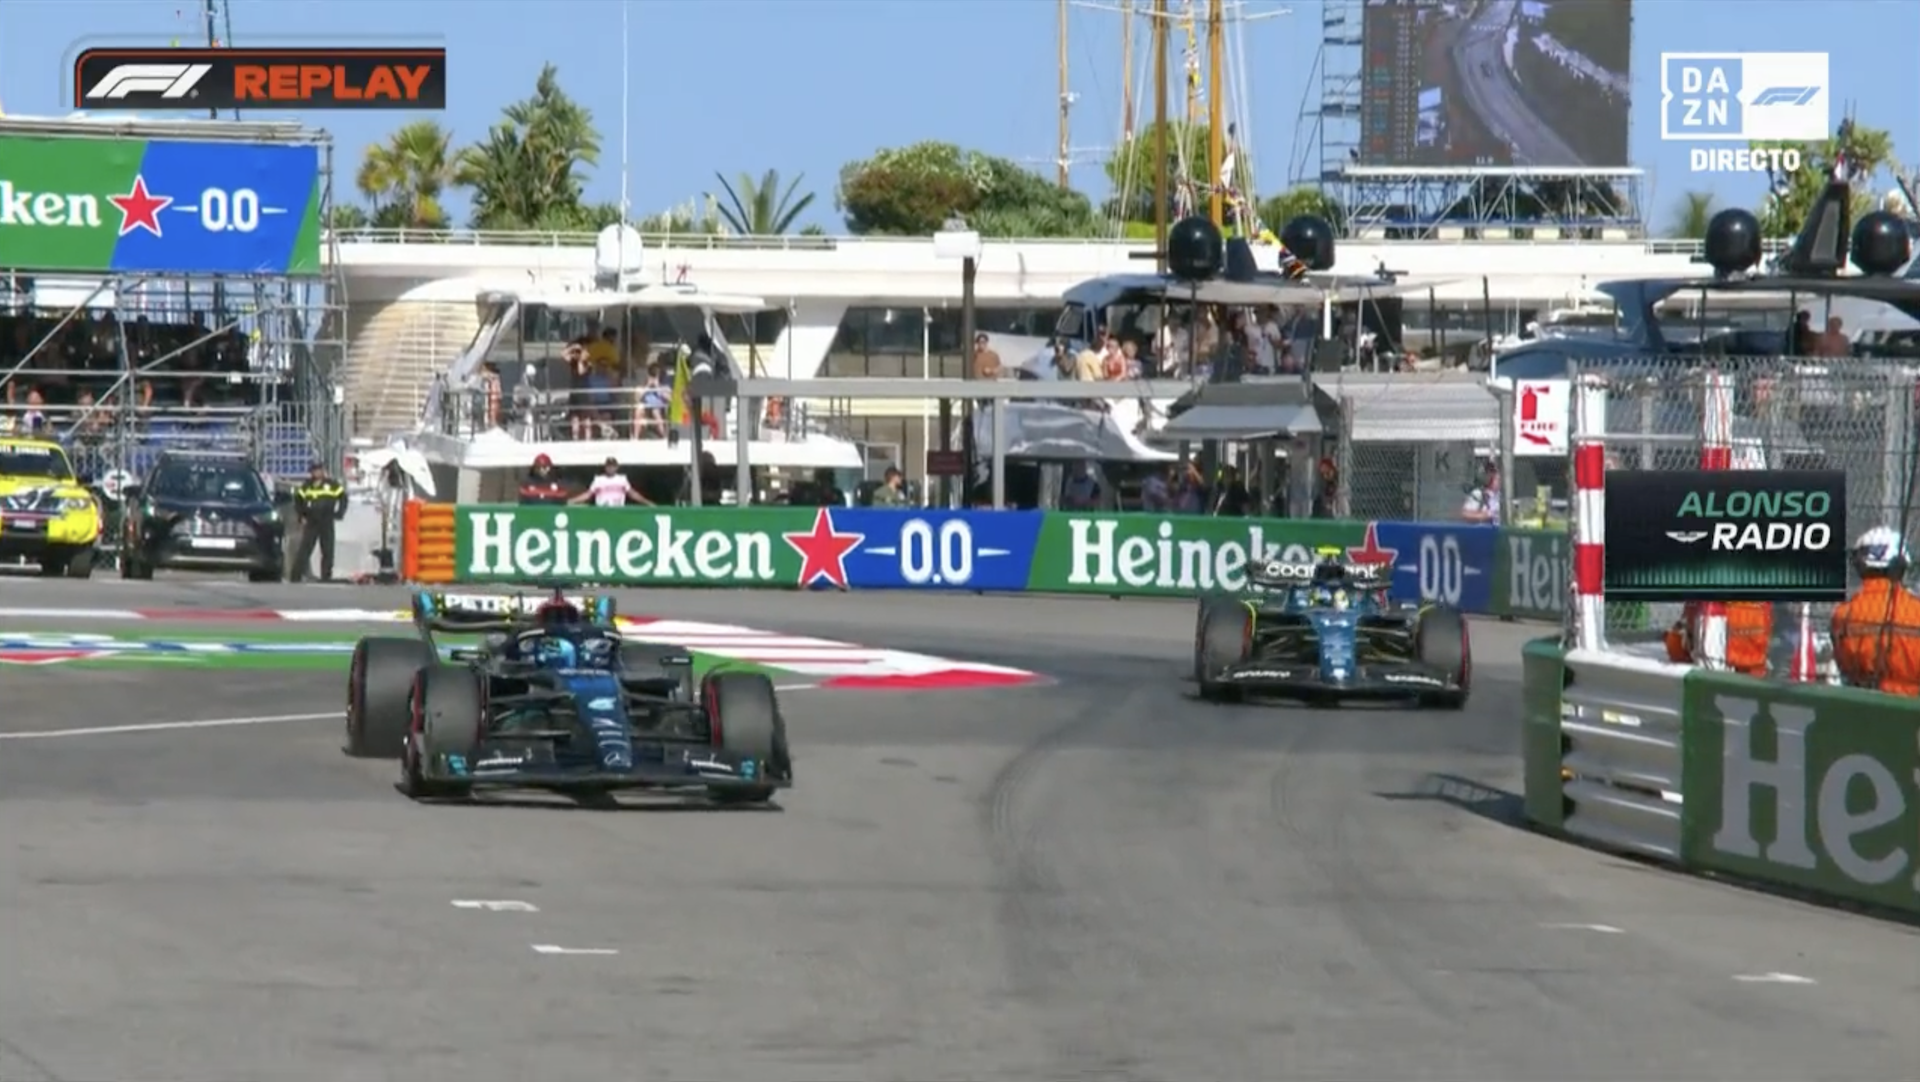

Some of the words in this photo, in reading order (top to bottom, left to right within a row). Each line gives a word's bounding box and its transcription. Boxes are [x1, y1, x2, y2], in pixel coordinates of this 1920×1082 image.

[0, 180, 102, 228] ken
[201, 188, 259, 232] 0.0
[1521, 422, 1558, 431] FIRE
[468, 512, 776, 580] Heineken
[900, 518, 972, 584] 0.0
[1508, 536, 1566, 611] Hei
[1713, 693, 1920, 885] He
